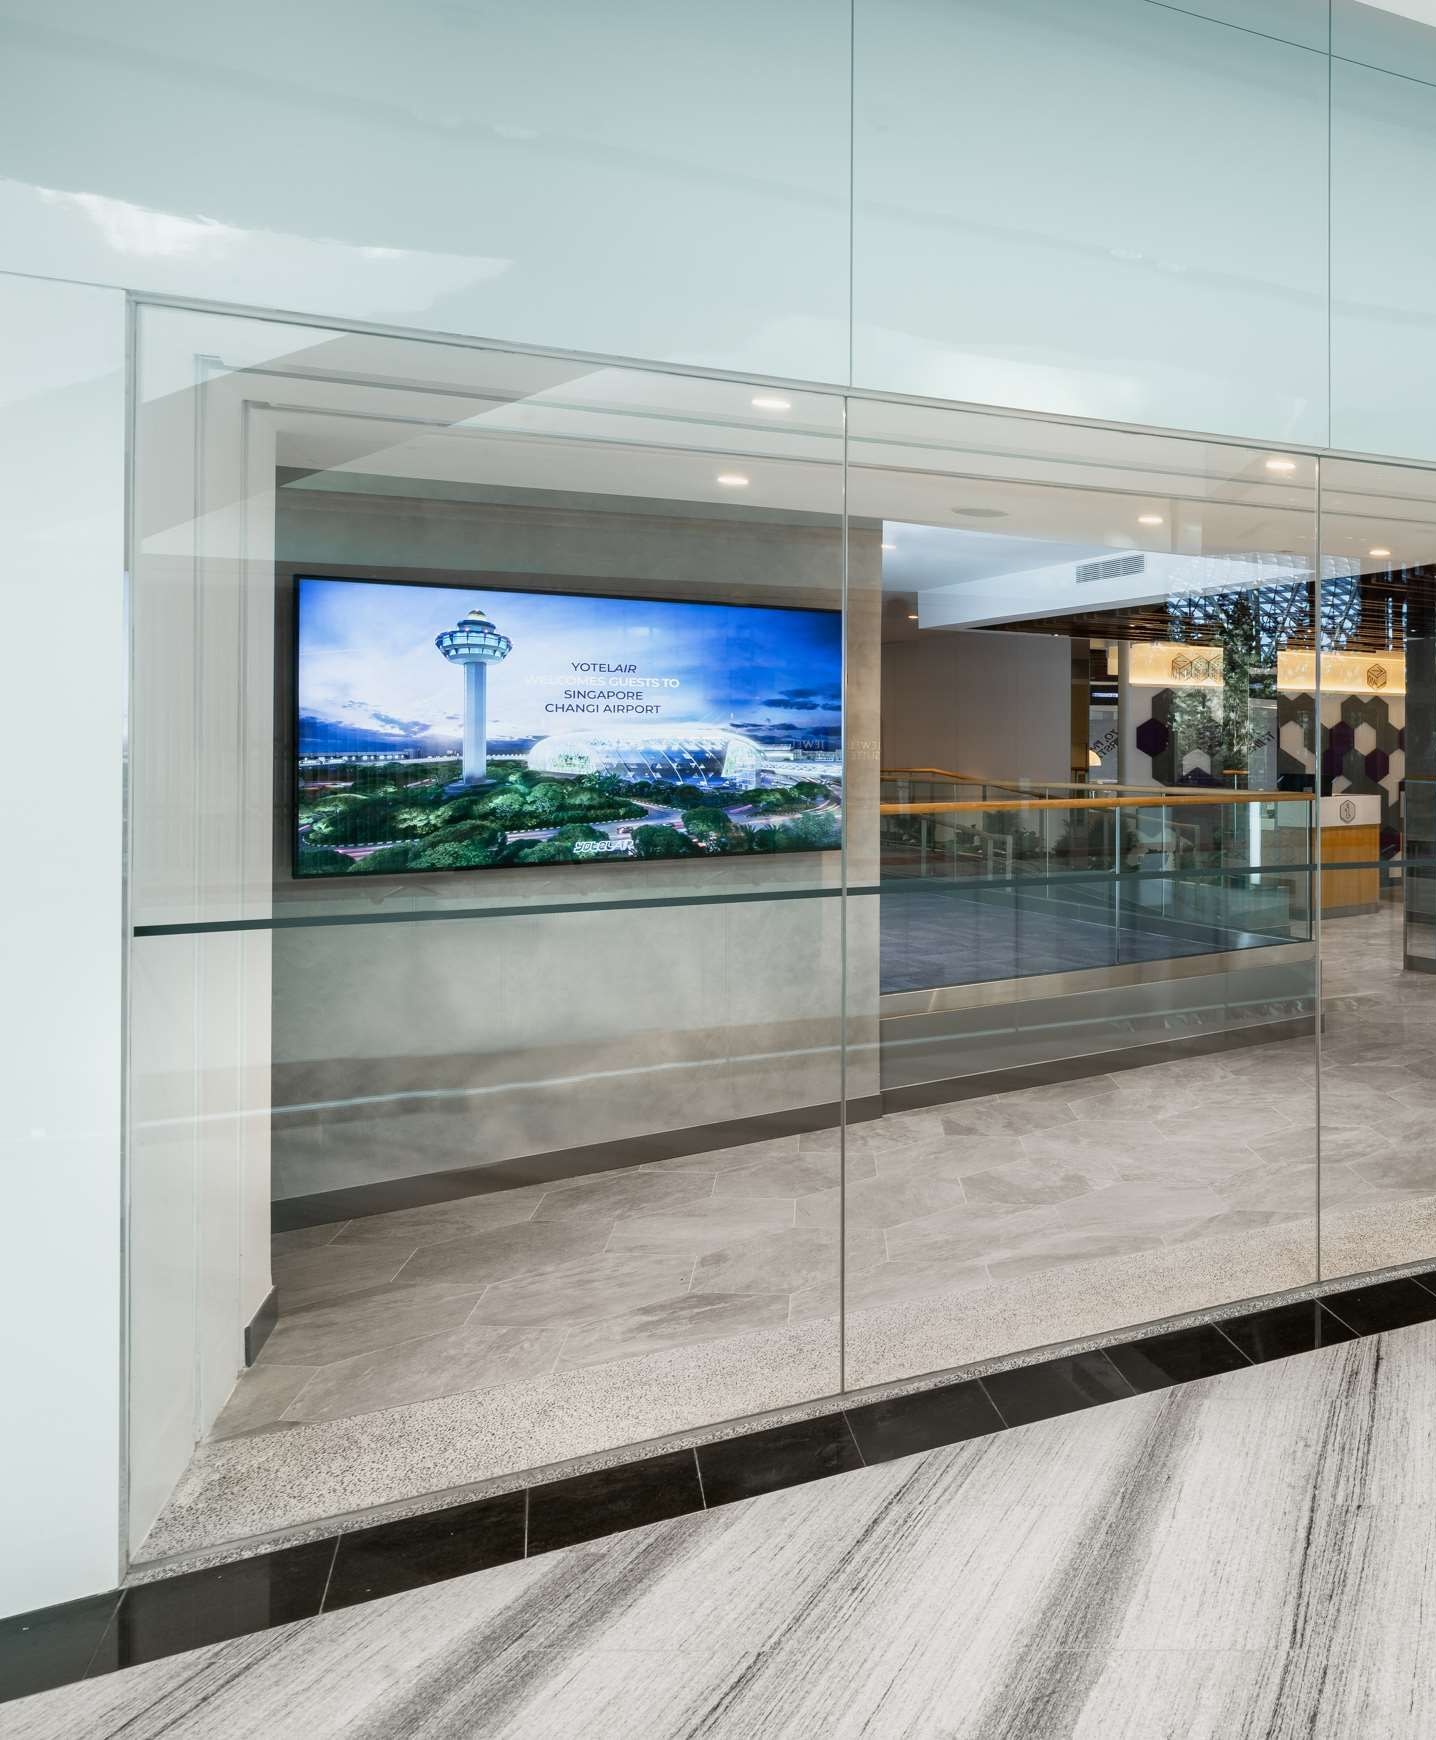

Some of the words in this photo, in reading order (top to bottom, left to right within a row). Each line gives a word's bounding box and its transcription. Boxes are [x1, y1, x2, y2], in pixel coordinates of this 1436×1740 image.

[571, 662, 637, 674] YOTELAIR
[608, 676, 660, 688] GUESTS
[661, 678, 680, 689] TO
[564, 689, 644, 701] SINGAPORE
[545, 703, 599, 713] CHANGI
[603, 704, 662, 714] AIRPORT
